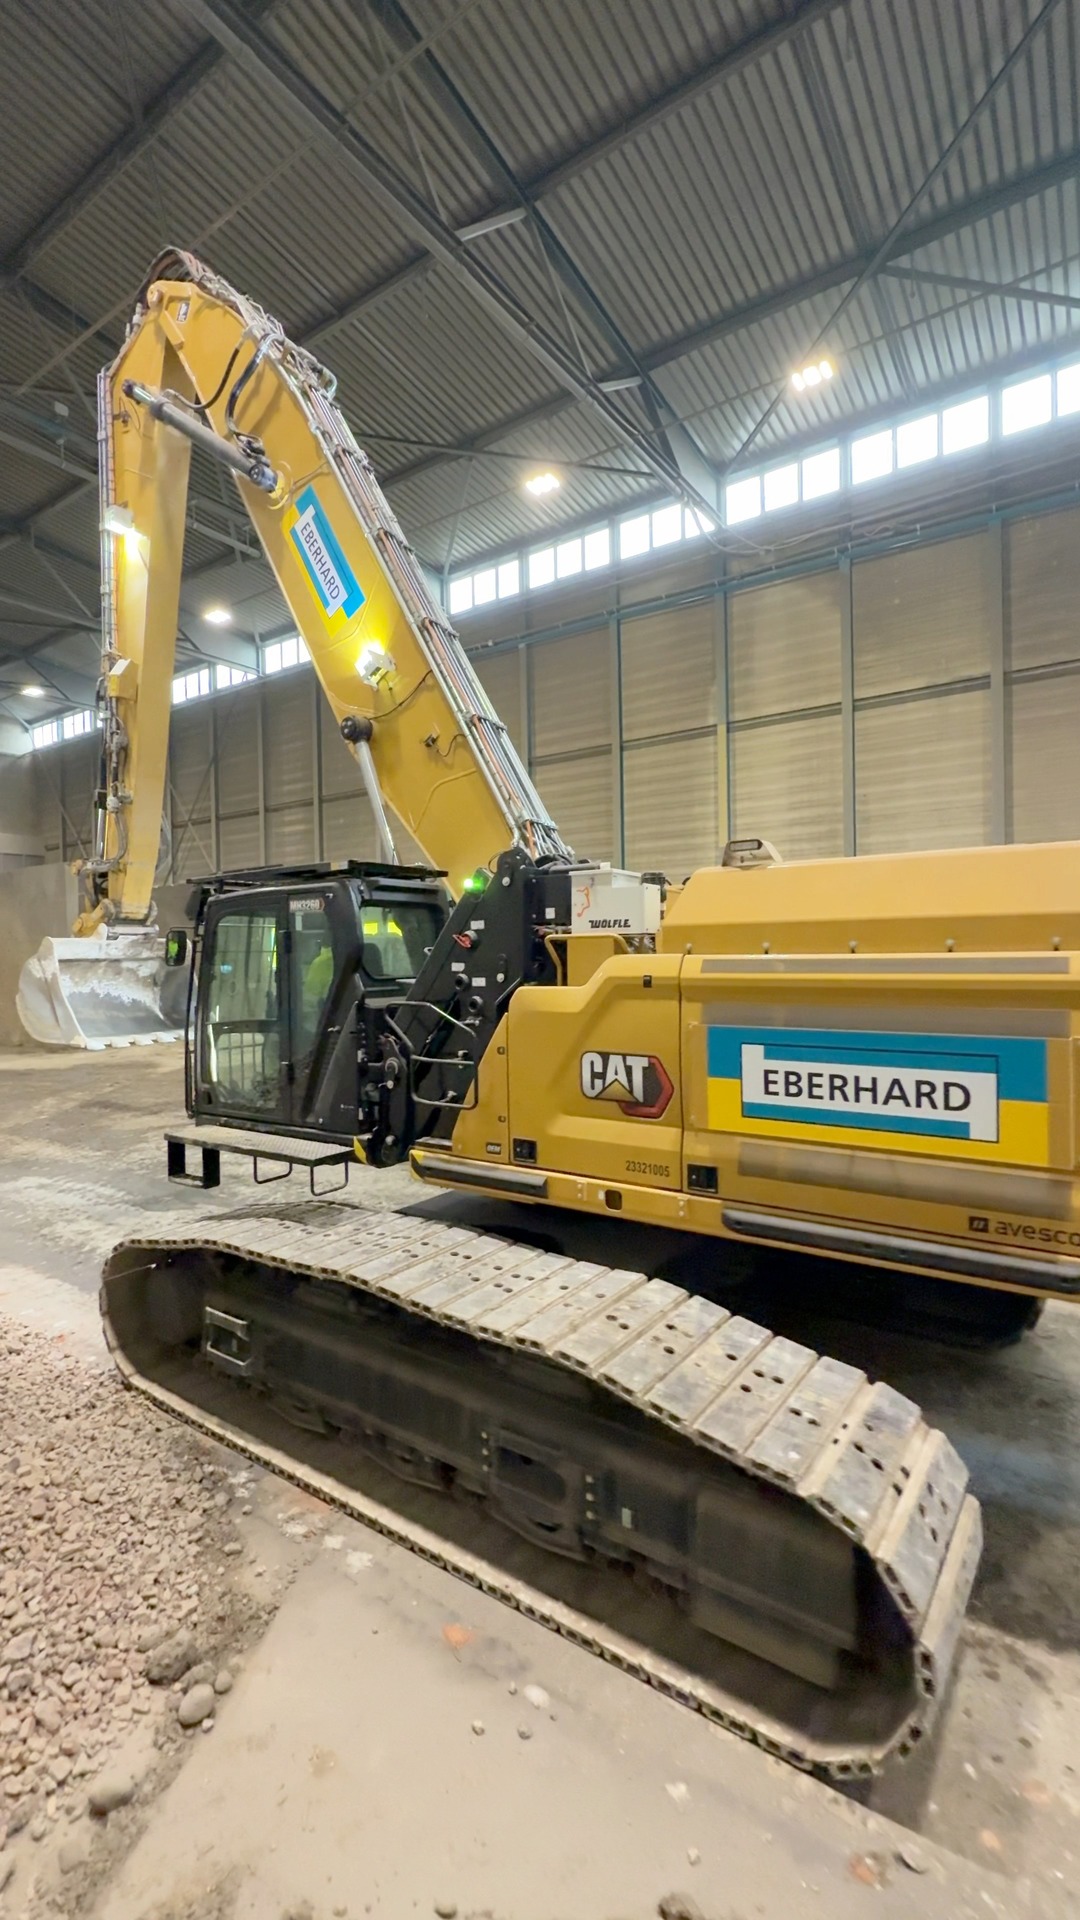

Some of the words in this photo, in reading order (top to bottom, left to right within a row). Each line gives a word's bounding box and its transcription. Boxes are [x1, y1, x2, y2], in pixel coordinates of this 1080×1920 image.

[300, 522, 340, 600] EBERHARD
[581, 1052, 649, 1103] CAT
[763, 1069, 971, 1112] EBERHARD
[625, 1160, 670, 1178] 23321005
[994, 1221, 1080, 1247] avesco
